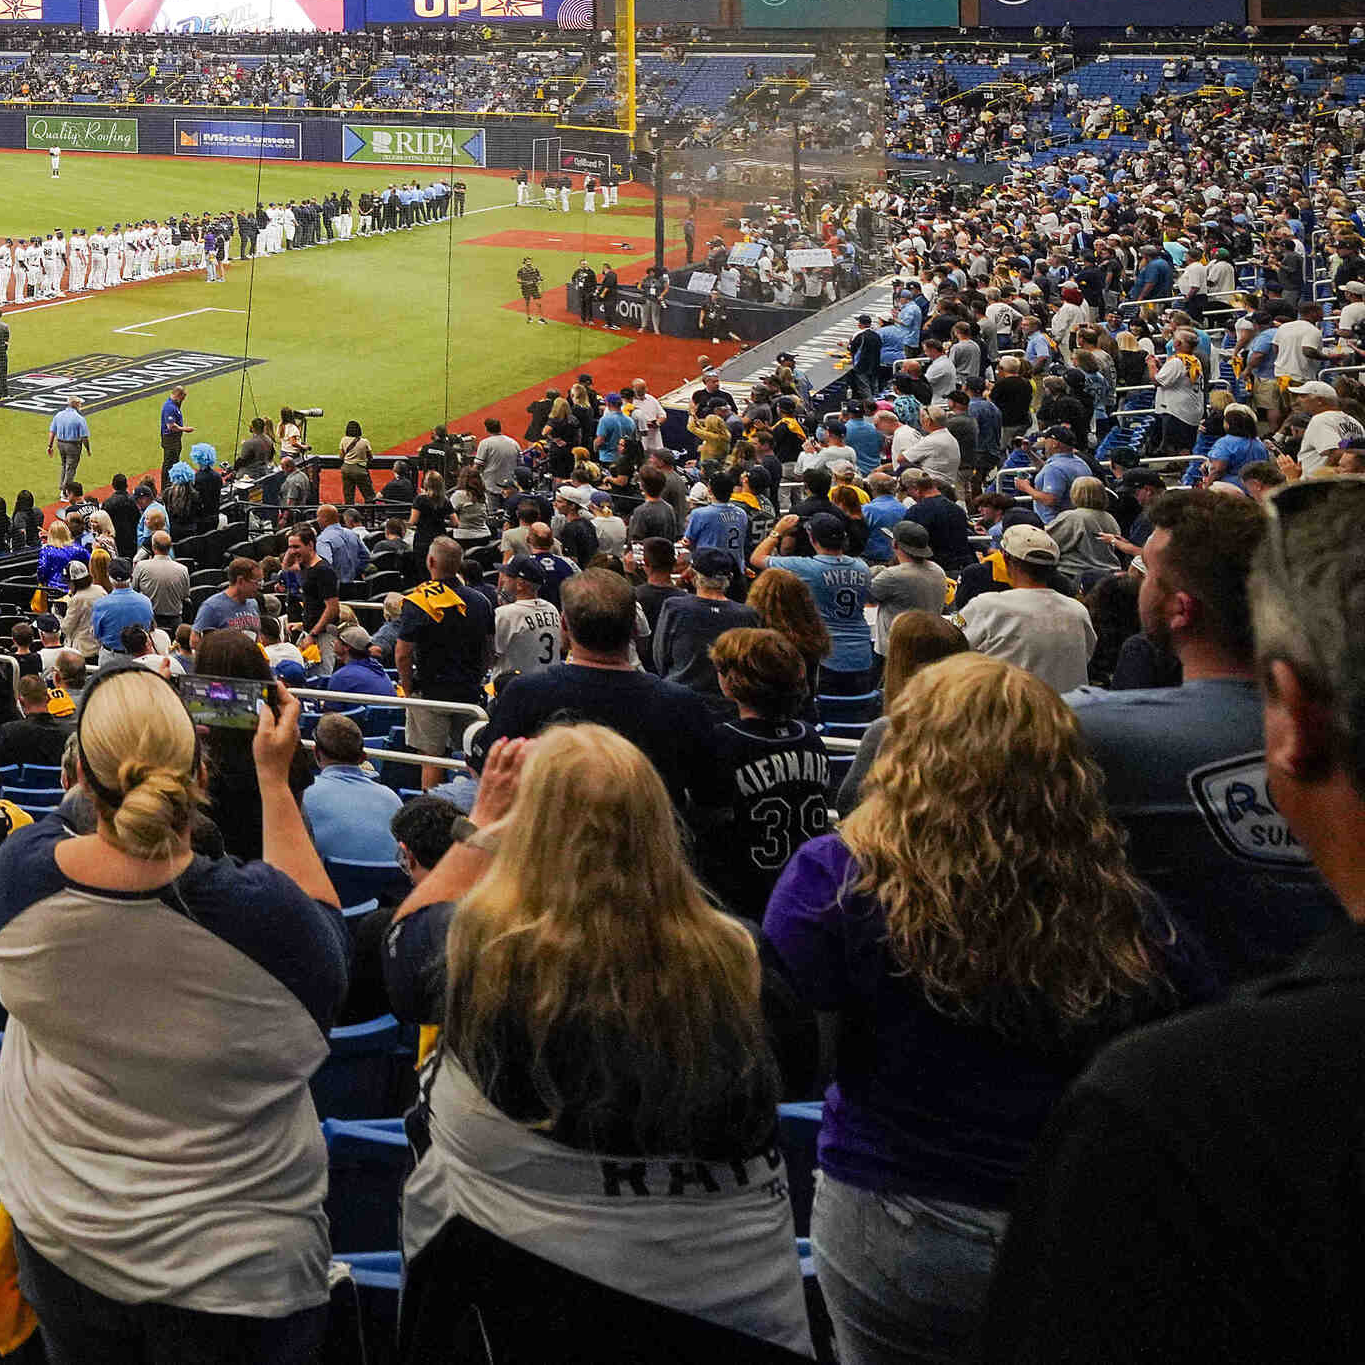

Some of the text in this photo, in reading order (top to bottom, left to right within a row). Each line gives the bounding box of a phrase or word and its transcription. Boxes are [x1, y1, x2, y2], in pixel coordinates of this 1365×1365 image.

[31, 119, 133, 147] Quality Roofing
[397, 132, 461, 156] RIPA
[5, 353, 237, 412] POSTSEASON
[727, 527, 740, 549] 2
[821, 569, 866, 587] MYERS
[833, 587, 859, 620] 9
